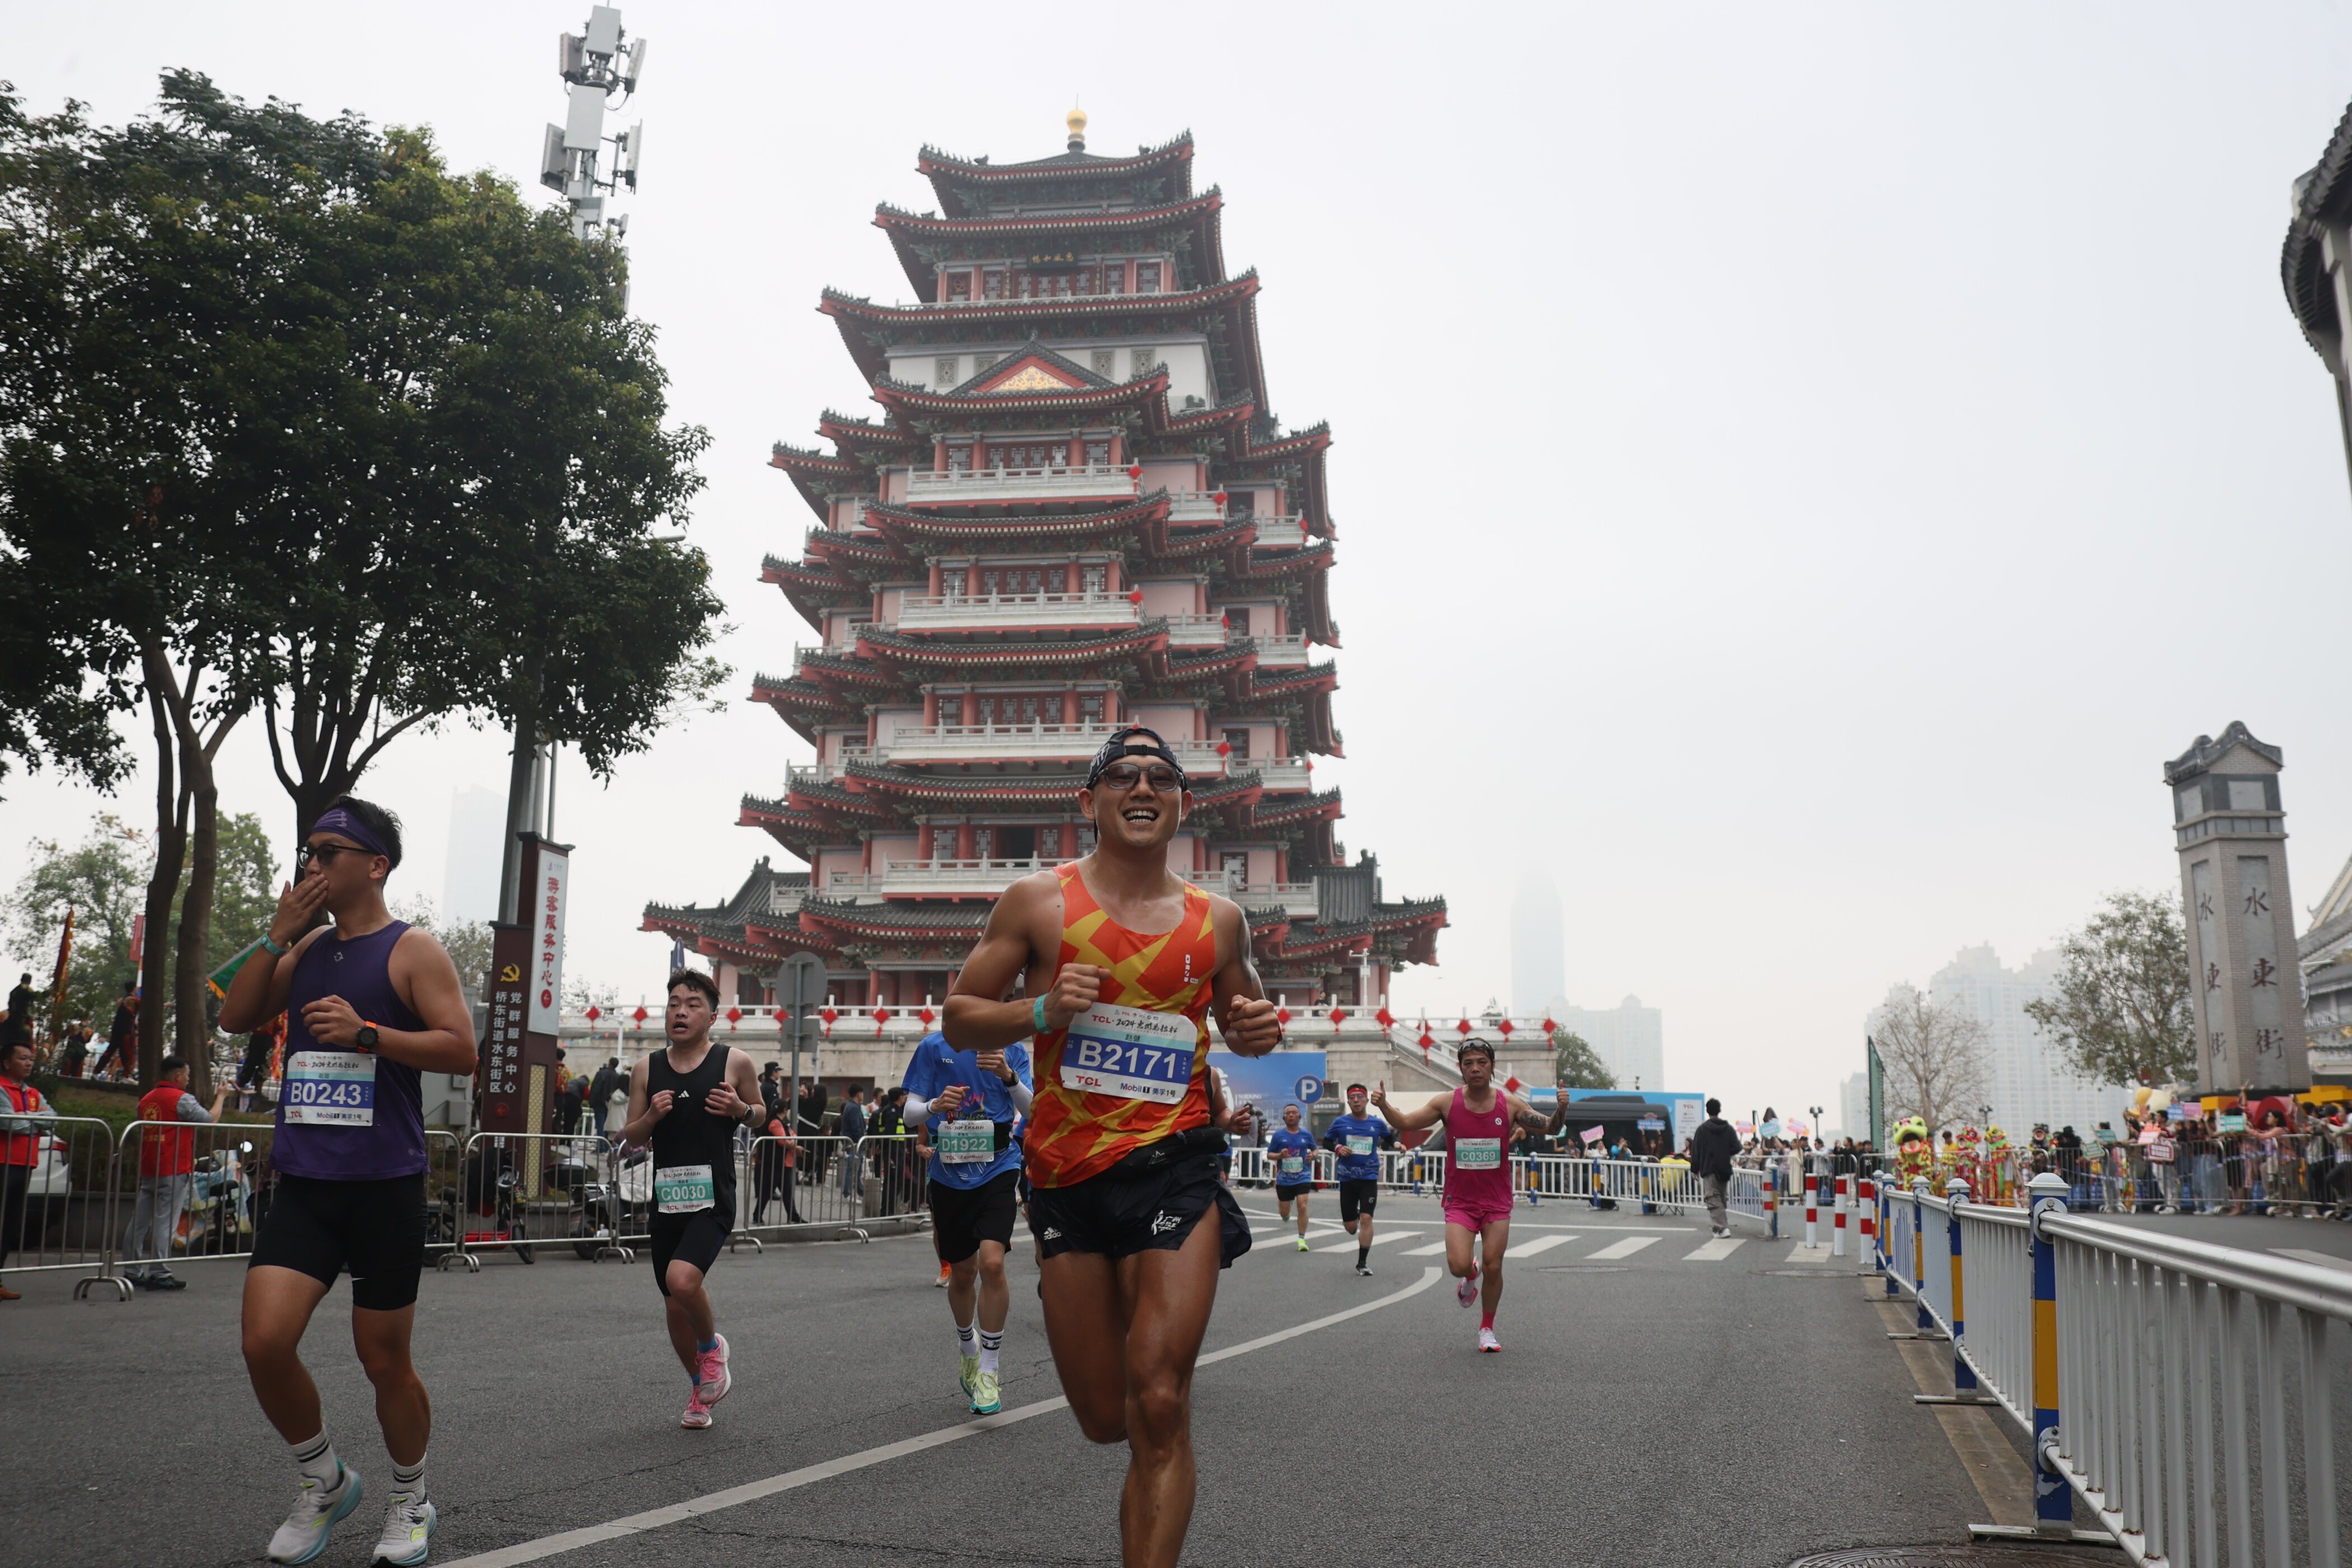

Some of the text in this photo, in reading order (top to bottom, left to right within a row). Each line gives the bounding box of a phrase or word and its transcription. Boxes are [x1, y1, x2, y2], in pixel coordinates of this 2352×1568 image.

[2243, 887, 2284, 1058] 水東街
[489, 990, 508, 1093] 桥东街道水东街区
[504, 991, 522, 1093] 党群服务中心
[1078, 1039, 1176, 1079] B2171
[1076, 1075, 1102, 1087] TCL
[1121, 1082, 1142, 1093] Mobil
[1301, 1079, 1317, 1100] P
[291, 1082, 361, 1105] B0243
[291, 1110, 302, 1119] TCL
[942, 1138, 987, 1151] D1922
[1461, 1151, 1496, 1161] C0369
[661, 1185, 706, 1201] C0030
